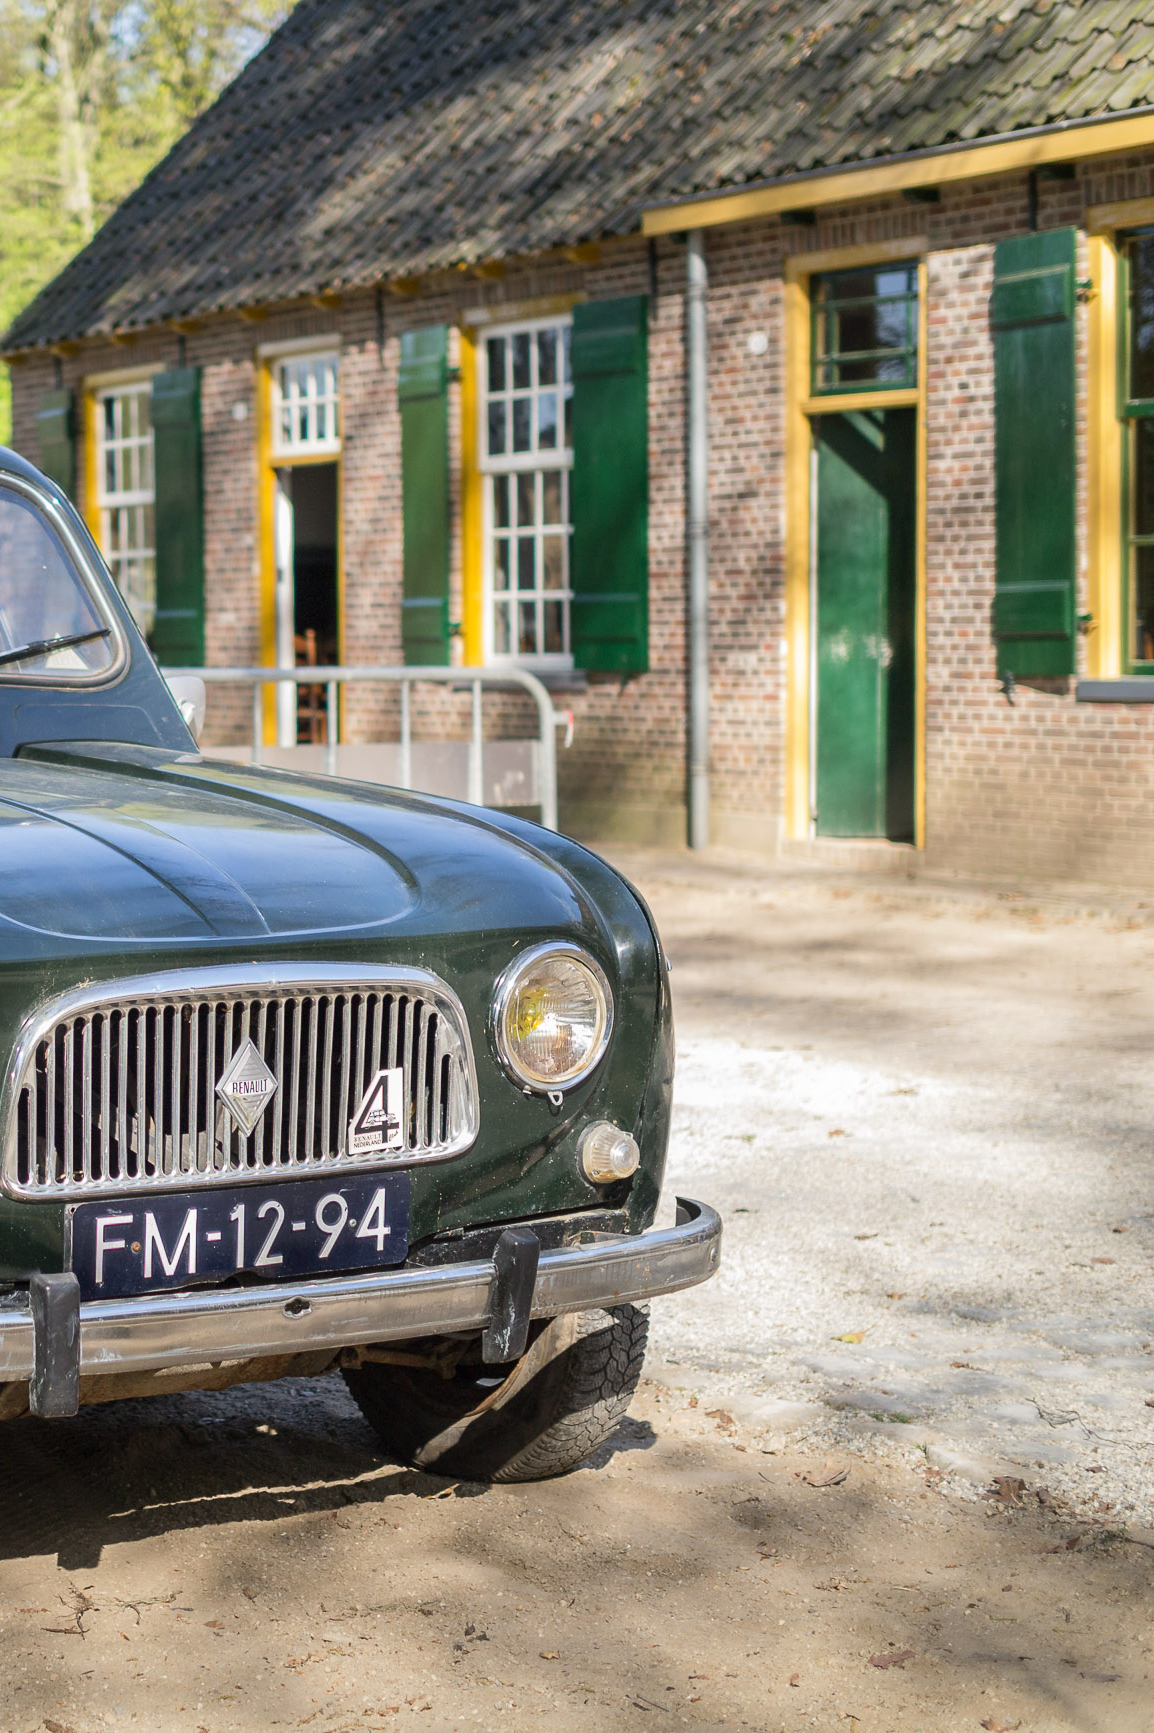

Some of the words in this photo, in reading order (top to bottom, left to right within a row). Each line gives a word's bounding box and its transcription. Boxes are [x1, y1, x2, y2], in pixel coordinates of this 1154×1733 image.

[232, 1079, 268, 1094] RENAULT
[354, 1074, 399, 1144] 4
[354, 1132, 381, 1142] RENAULT
[354, 1139, 381, 1148] NEDERLAND
[95, 1187, 391, 1284] FM-12-94
